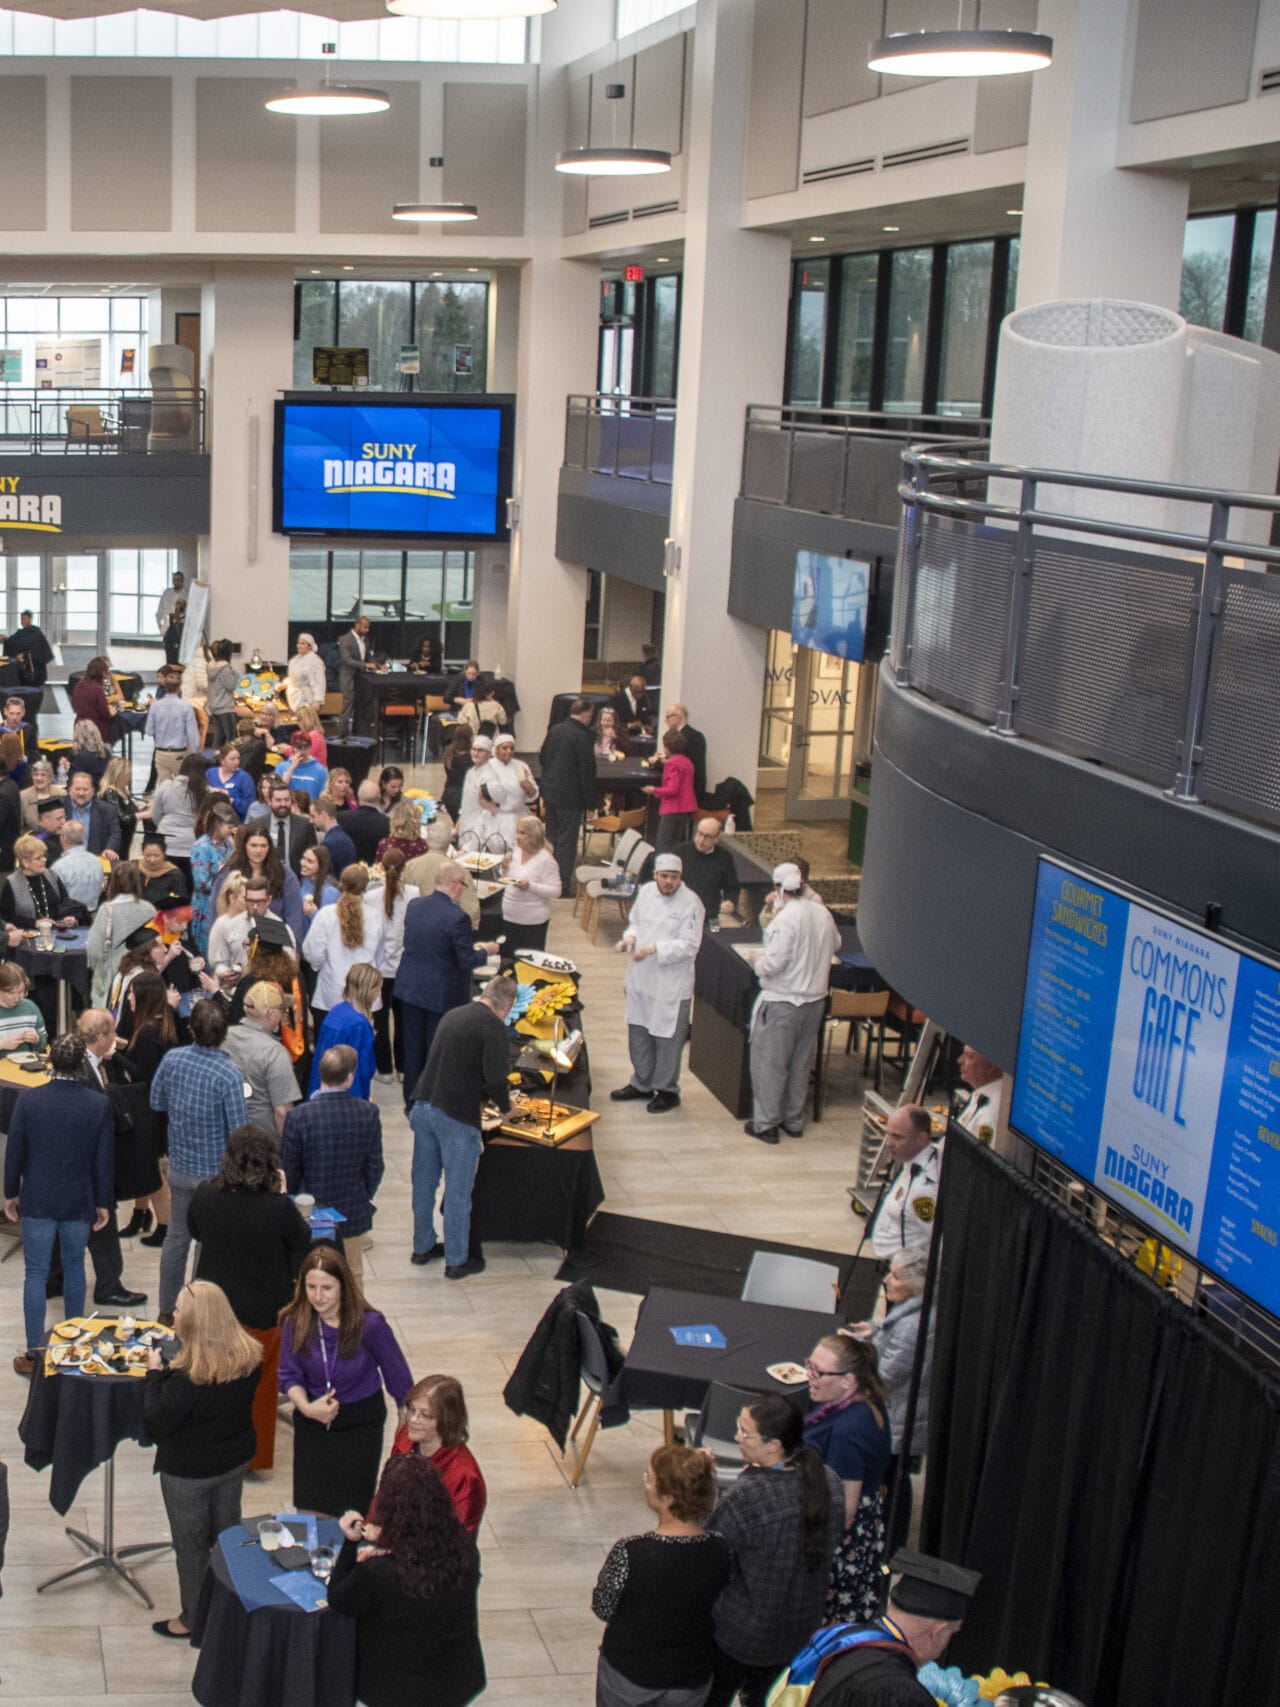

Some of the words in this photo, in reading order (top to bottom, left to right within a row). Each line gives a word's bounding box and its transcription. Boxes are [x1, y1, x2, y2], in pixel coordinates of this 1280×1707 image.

[362, 443, 416, 460] SUNY
[324, 460, 456, 491] NIAGARA
[1061, 879, 1104, 918] GOURMET
[1051, 899, 1107, 948] SANDWICHES
[1176, 936, 1210, 960] NIAGARA
[1130, 935, 1227, 1018] COMMONS
[1133, 985, 1201, 1128] CAFE
[1132, 1143, 1170, 1180] SUNY
[1104, 1145, 1194, 1234] NIAGARA
